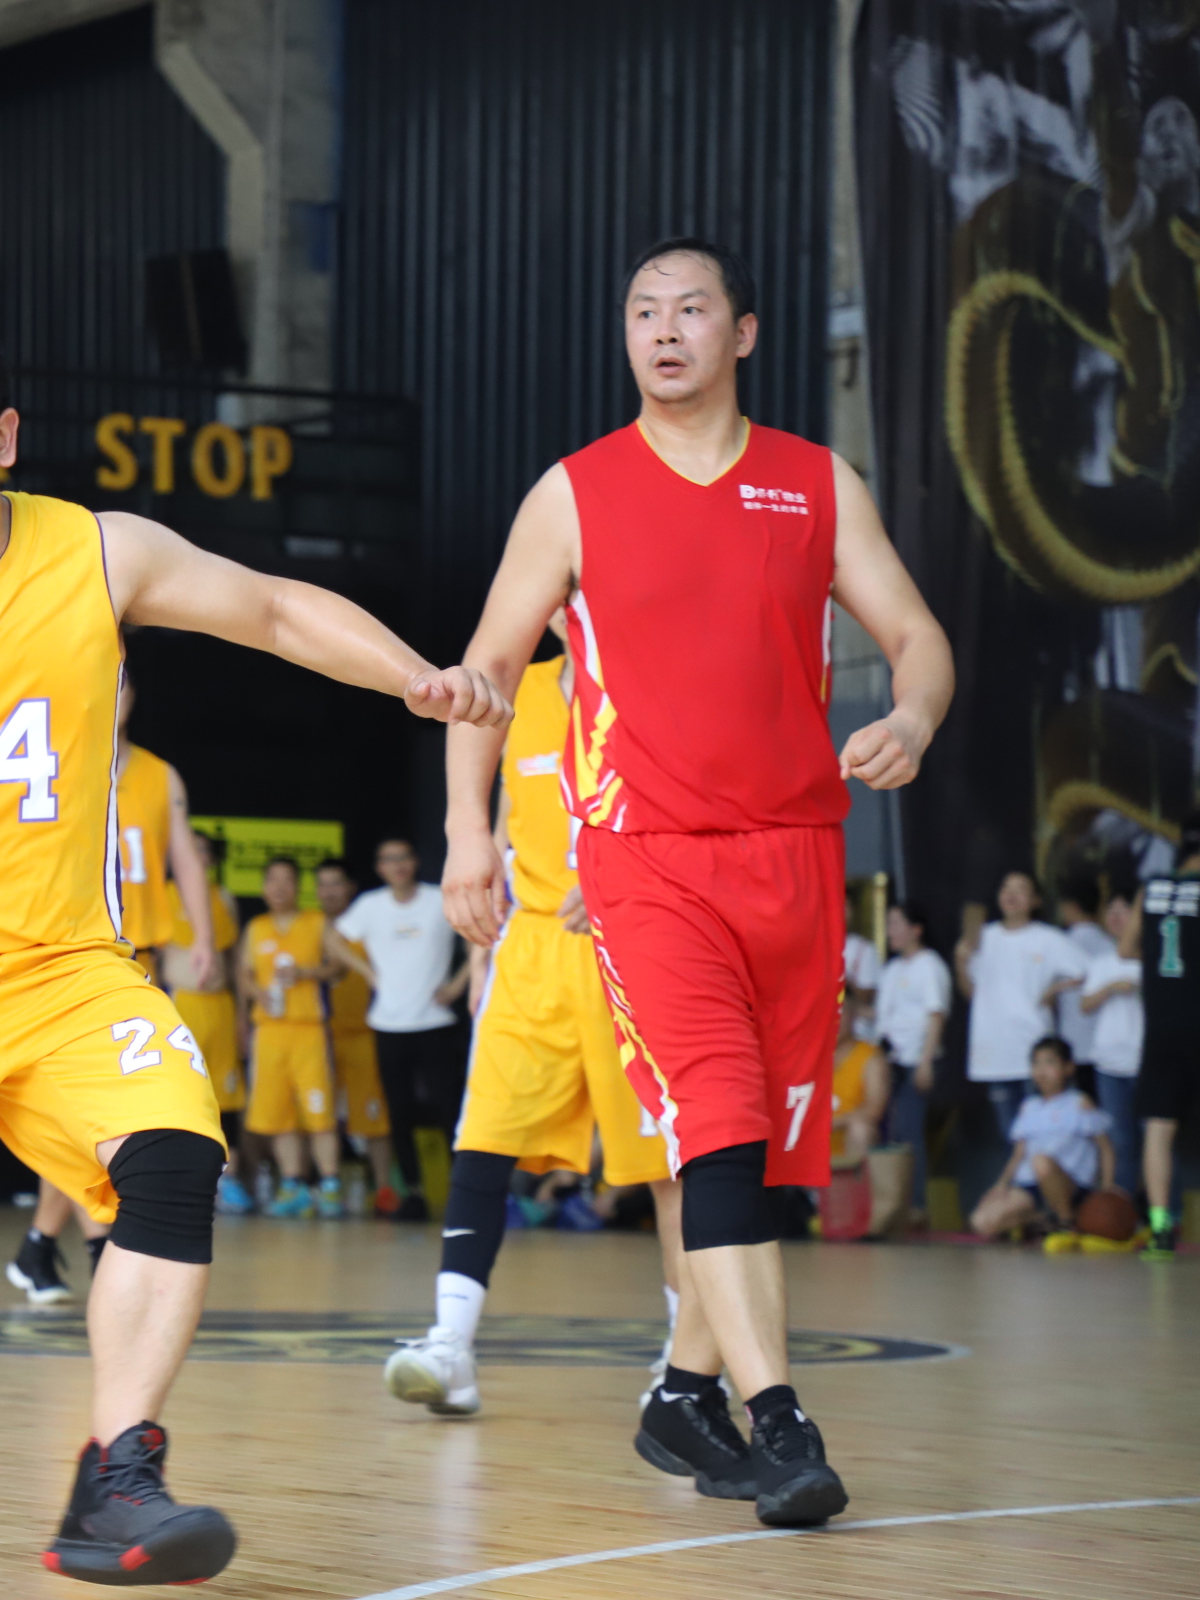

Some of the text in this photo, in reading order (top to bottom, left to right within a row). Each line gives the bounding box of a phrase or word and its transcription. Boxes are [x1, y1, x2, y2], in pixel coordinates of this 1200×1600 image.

[94, 413, 293, 502] STOP
[111, 1016, 208, 1079] 24
[785, 1081, 816, 1152] 7
